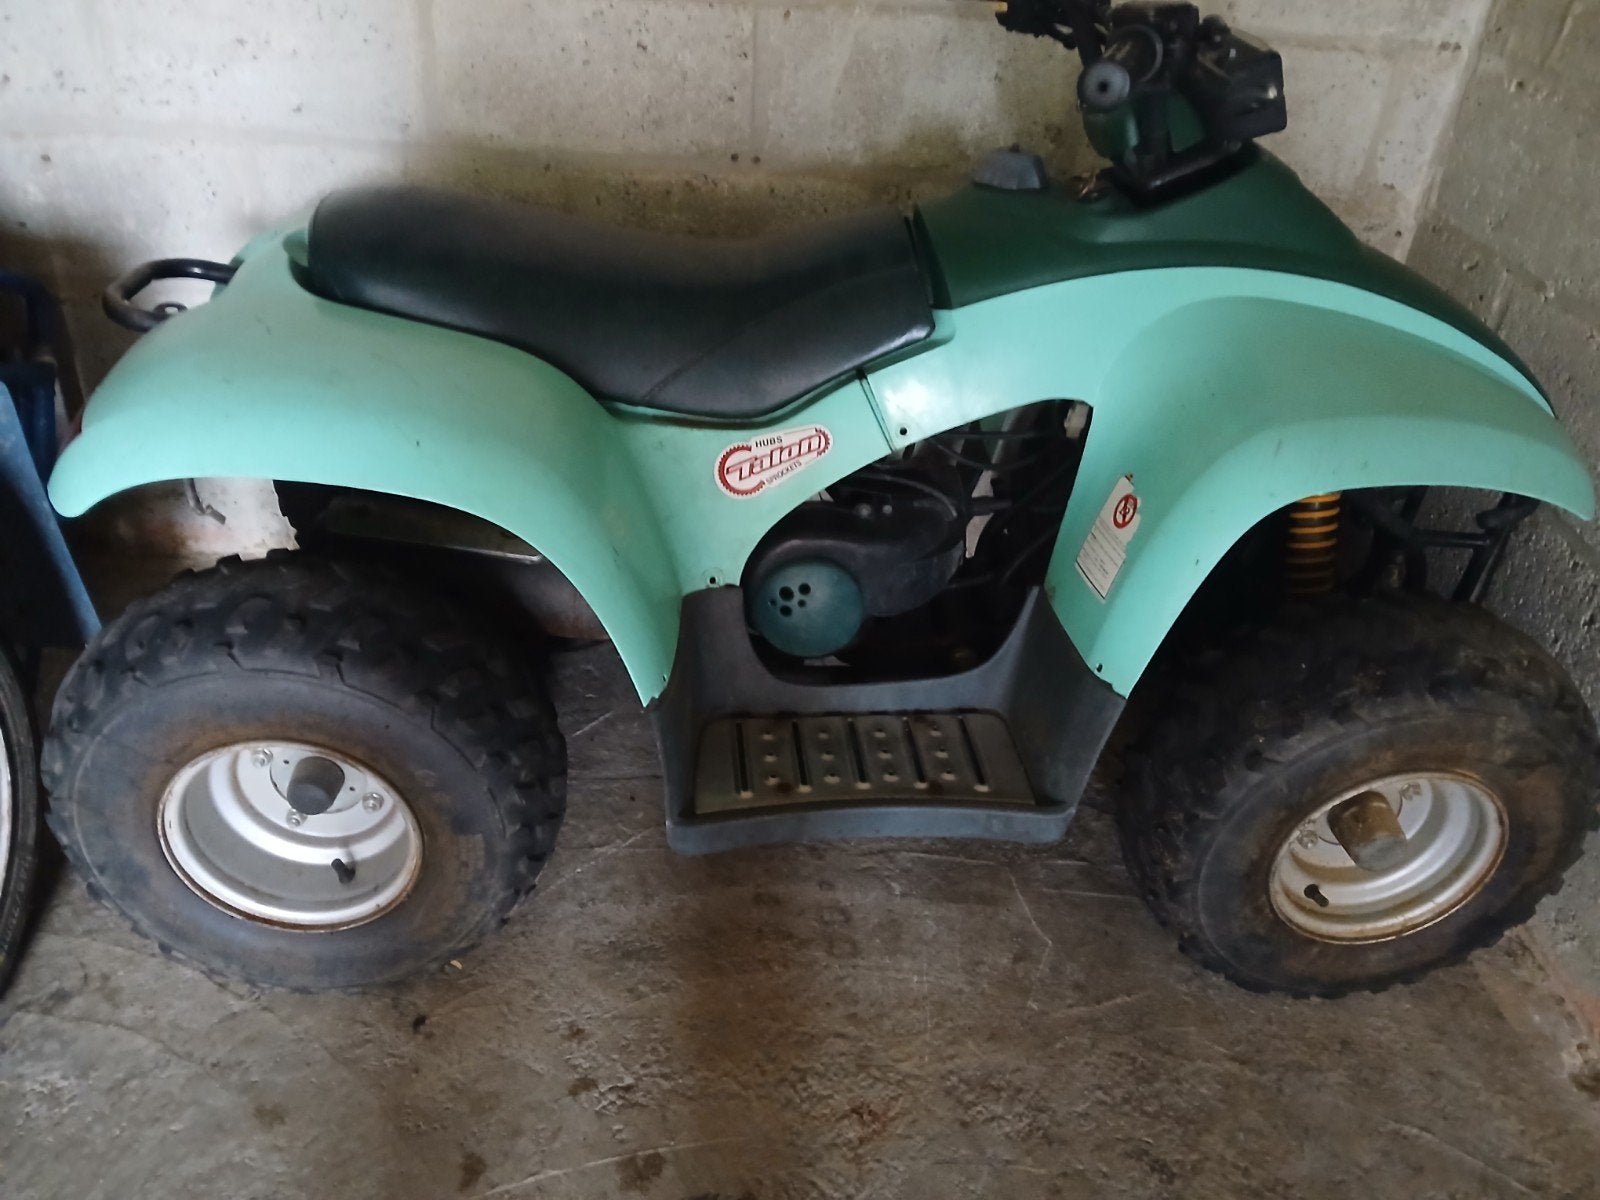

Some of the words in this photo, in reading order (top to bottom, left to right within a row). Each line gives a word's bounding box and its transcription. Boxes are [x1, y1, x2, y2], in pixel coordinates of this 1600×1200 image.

[755, 435, 783, 448] HUBS
[726, 432, 822, 481] Talon
[766, 459, 803, 484] SPROCKETS
